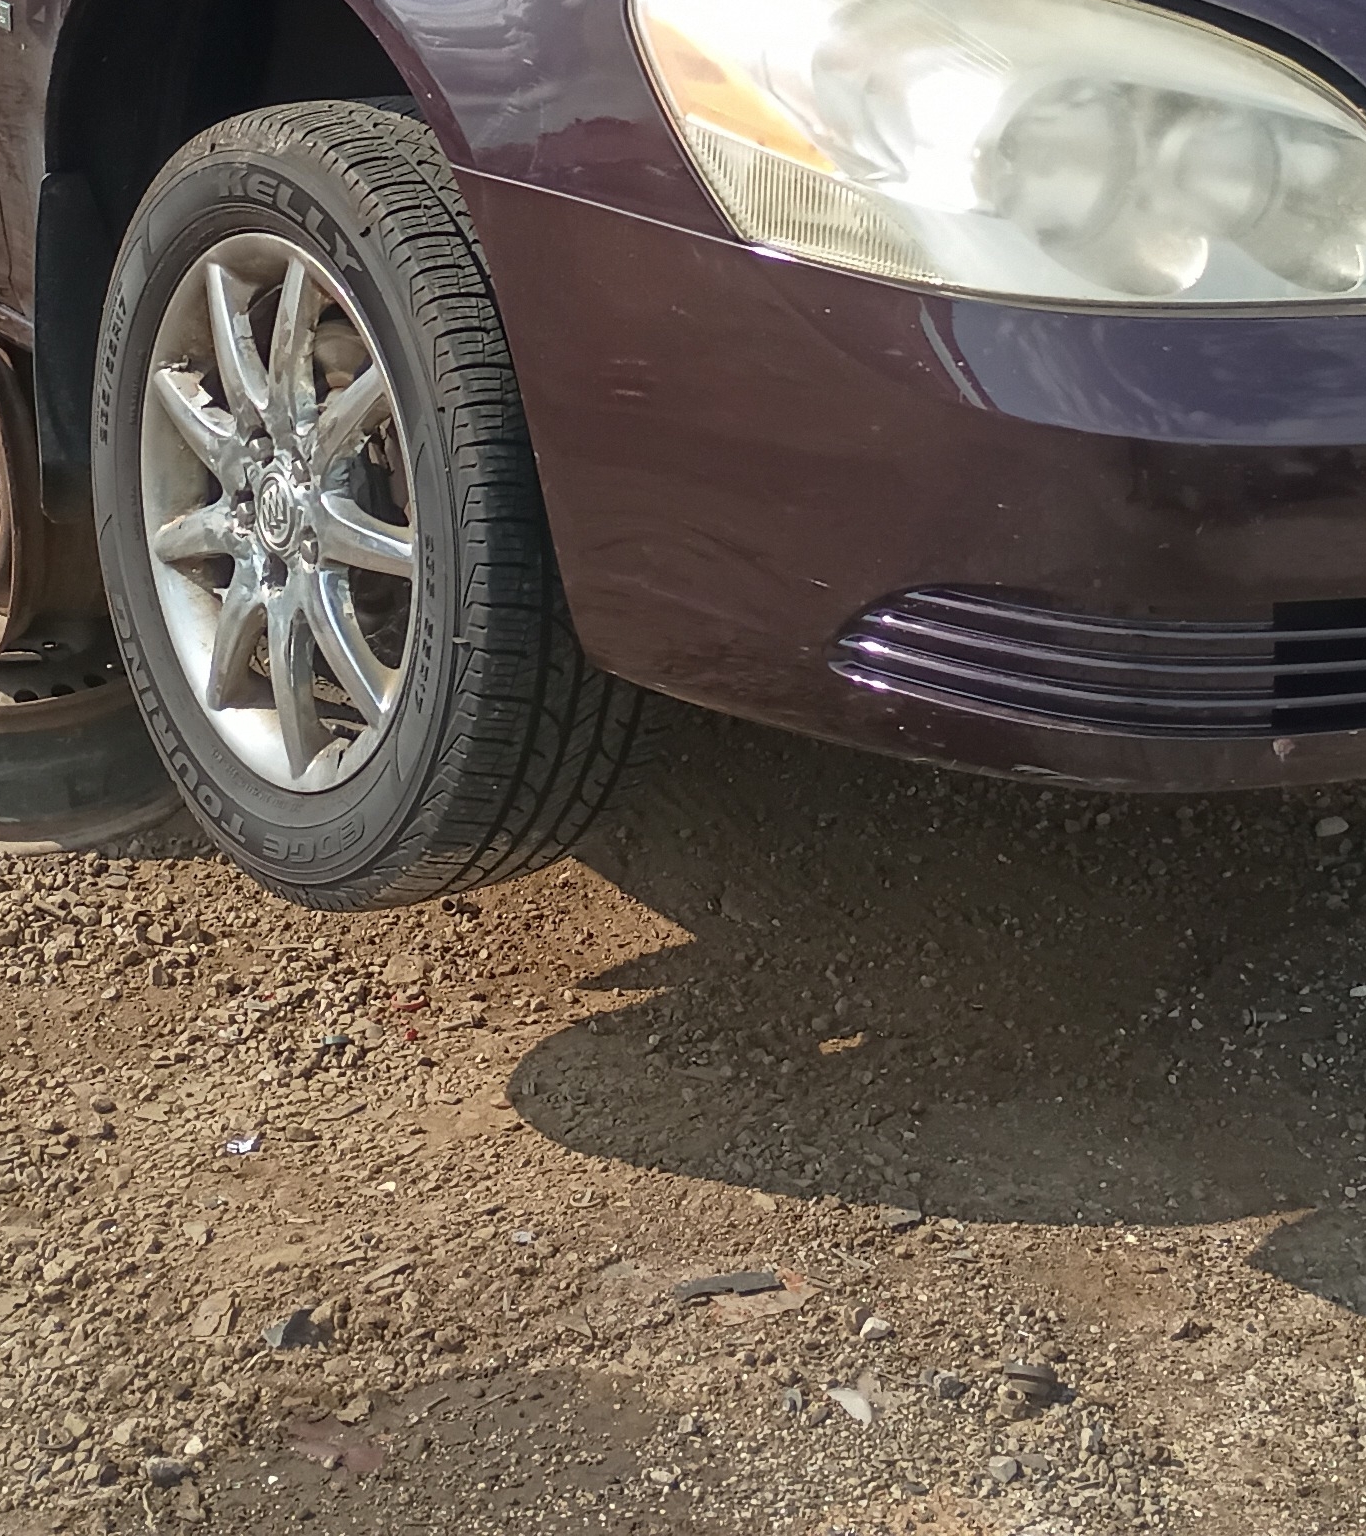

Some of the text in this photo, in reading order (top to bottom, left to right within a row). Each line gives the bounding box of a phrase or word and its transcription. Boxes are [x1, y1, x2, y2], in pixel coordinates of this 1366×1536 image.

[218, 167, 364, 272] KELLY
[108, 593, 247, 844] TOURING
[262, 810, 366, 863] EDGE
